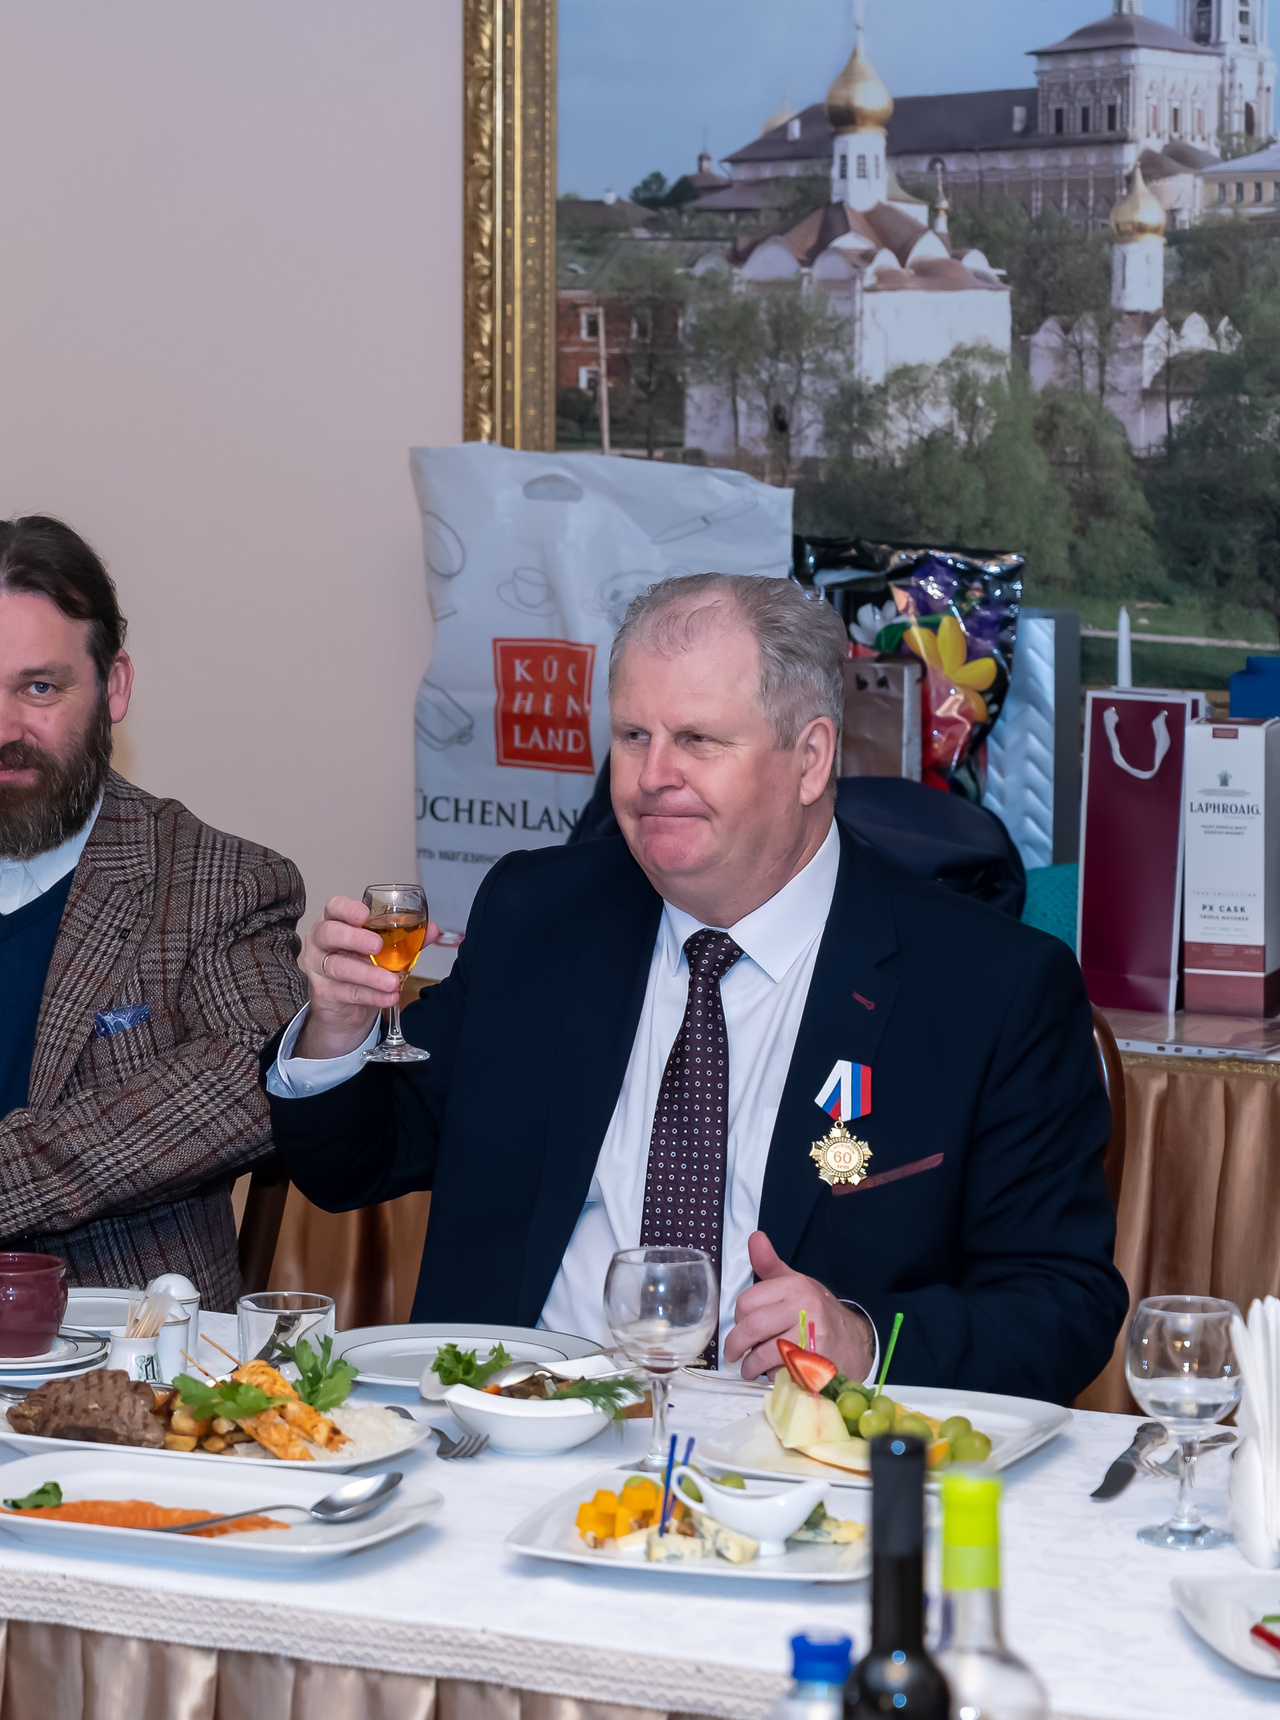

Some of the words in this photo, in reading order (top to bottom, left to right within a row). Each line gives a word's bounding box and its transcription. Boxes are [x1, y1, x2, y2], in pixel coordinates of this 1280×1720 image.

[511, 691, 584, 719] HEN
[513, 724, 586, 754] LAND
[415, 788, 579, 833] ÜCHENLAN
[1202, 904, 1214, 912] PX
[1219, 905, 1246, 913] CASK
[833, 1151, 852, 1164] 60
